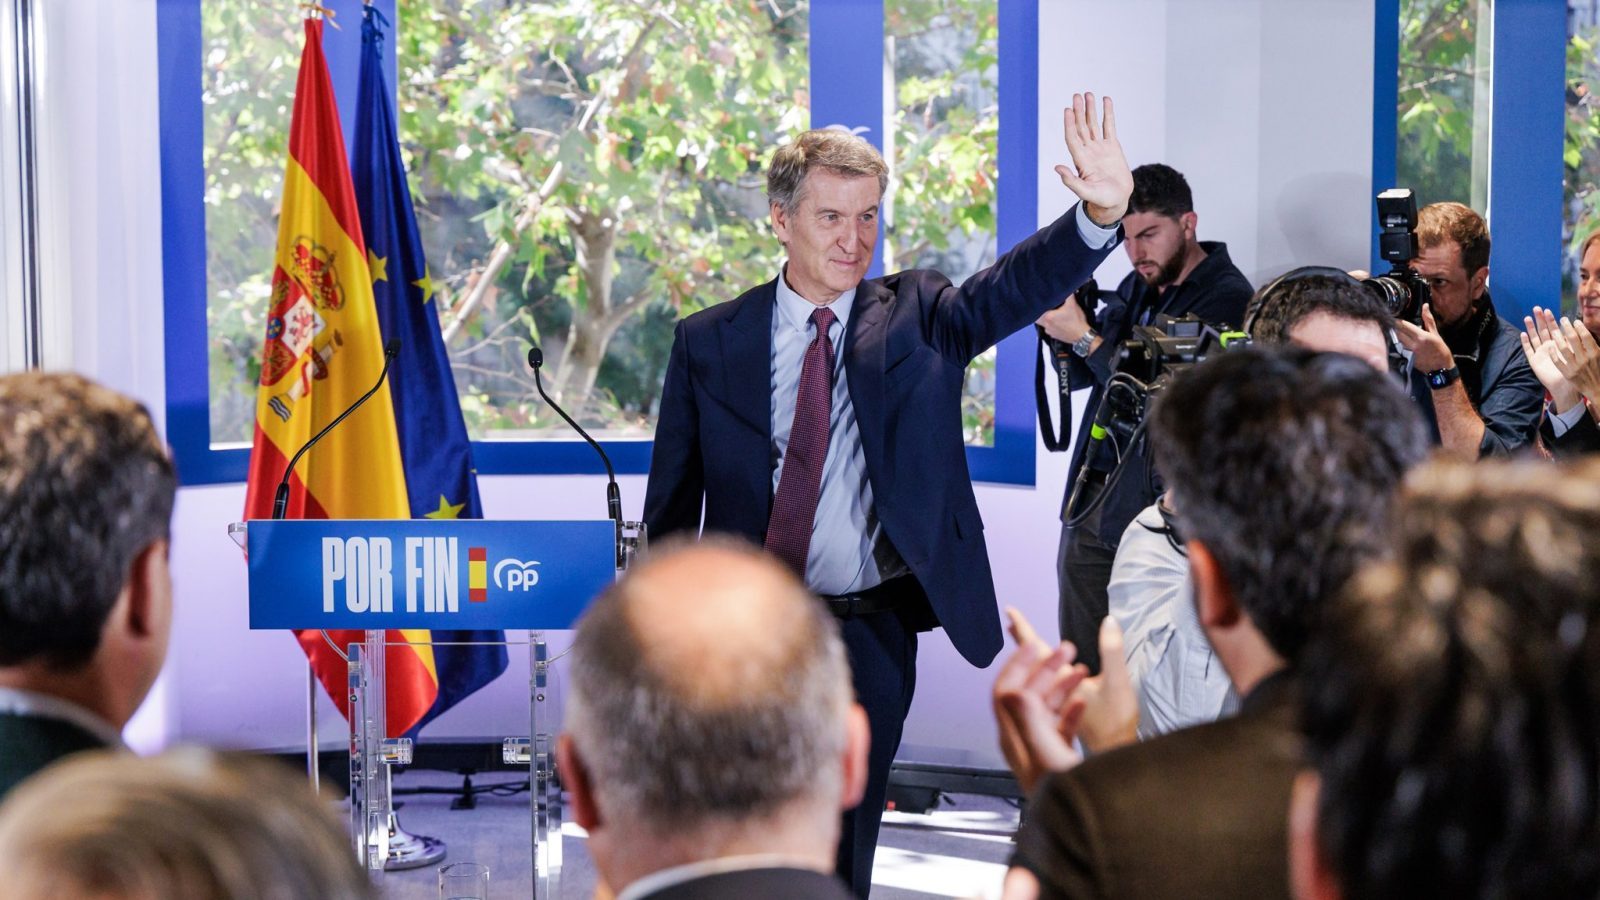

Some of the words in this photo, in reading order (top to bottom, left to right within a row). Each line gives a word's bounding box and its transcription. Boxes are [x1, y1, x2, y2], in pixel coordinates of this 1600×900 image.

[1059, 360, 1069, 396] SONY
[322, 536, 394, 613] POR
[405, 536, 459, 613] FIN
